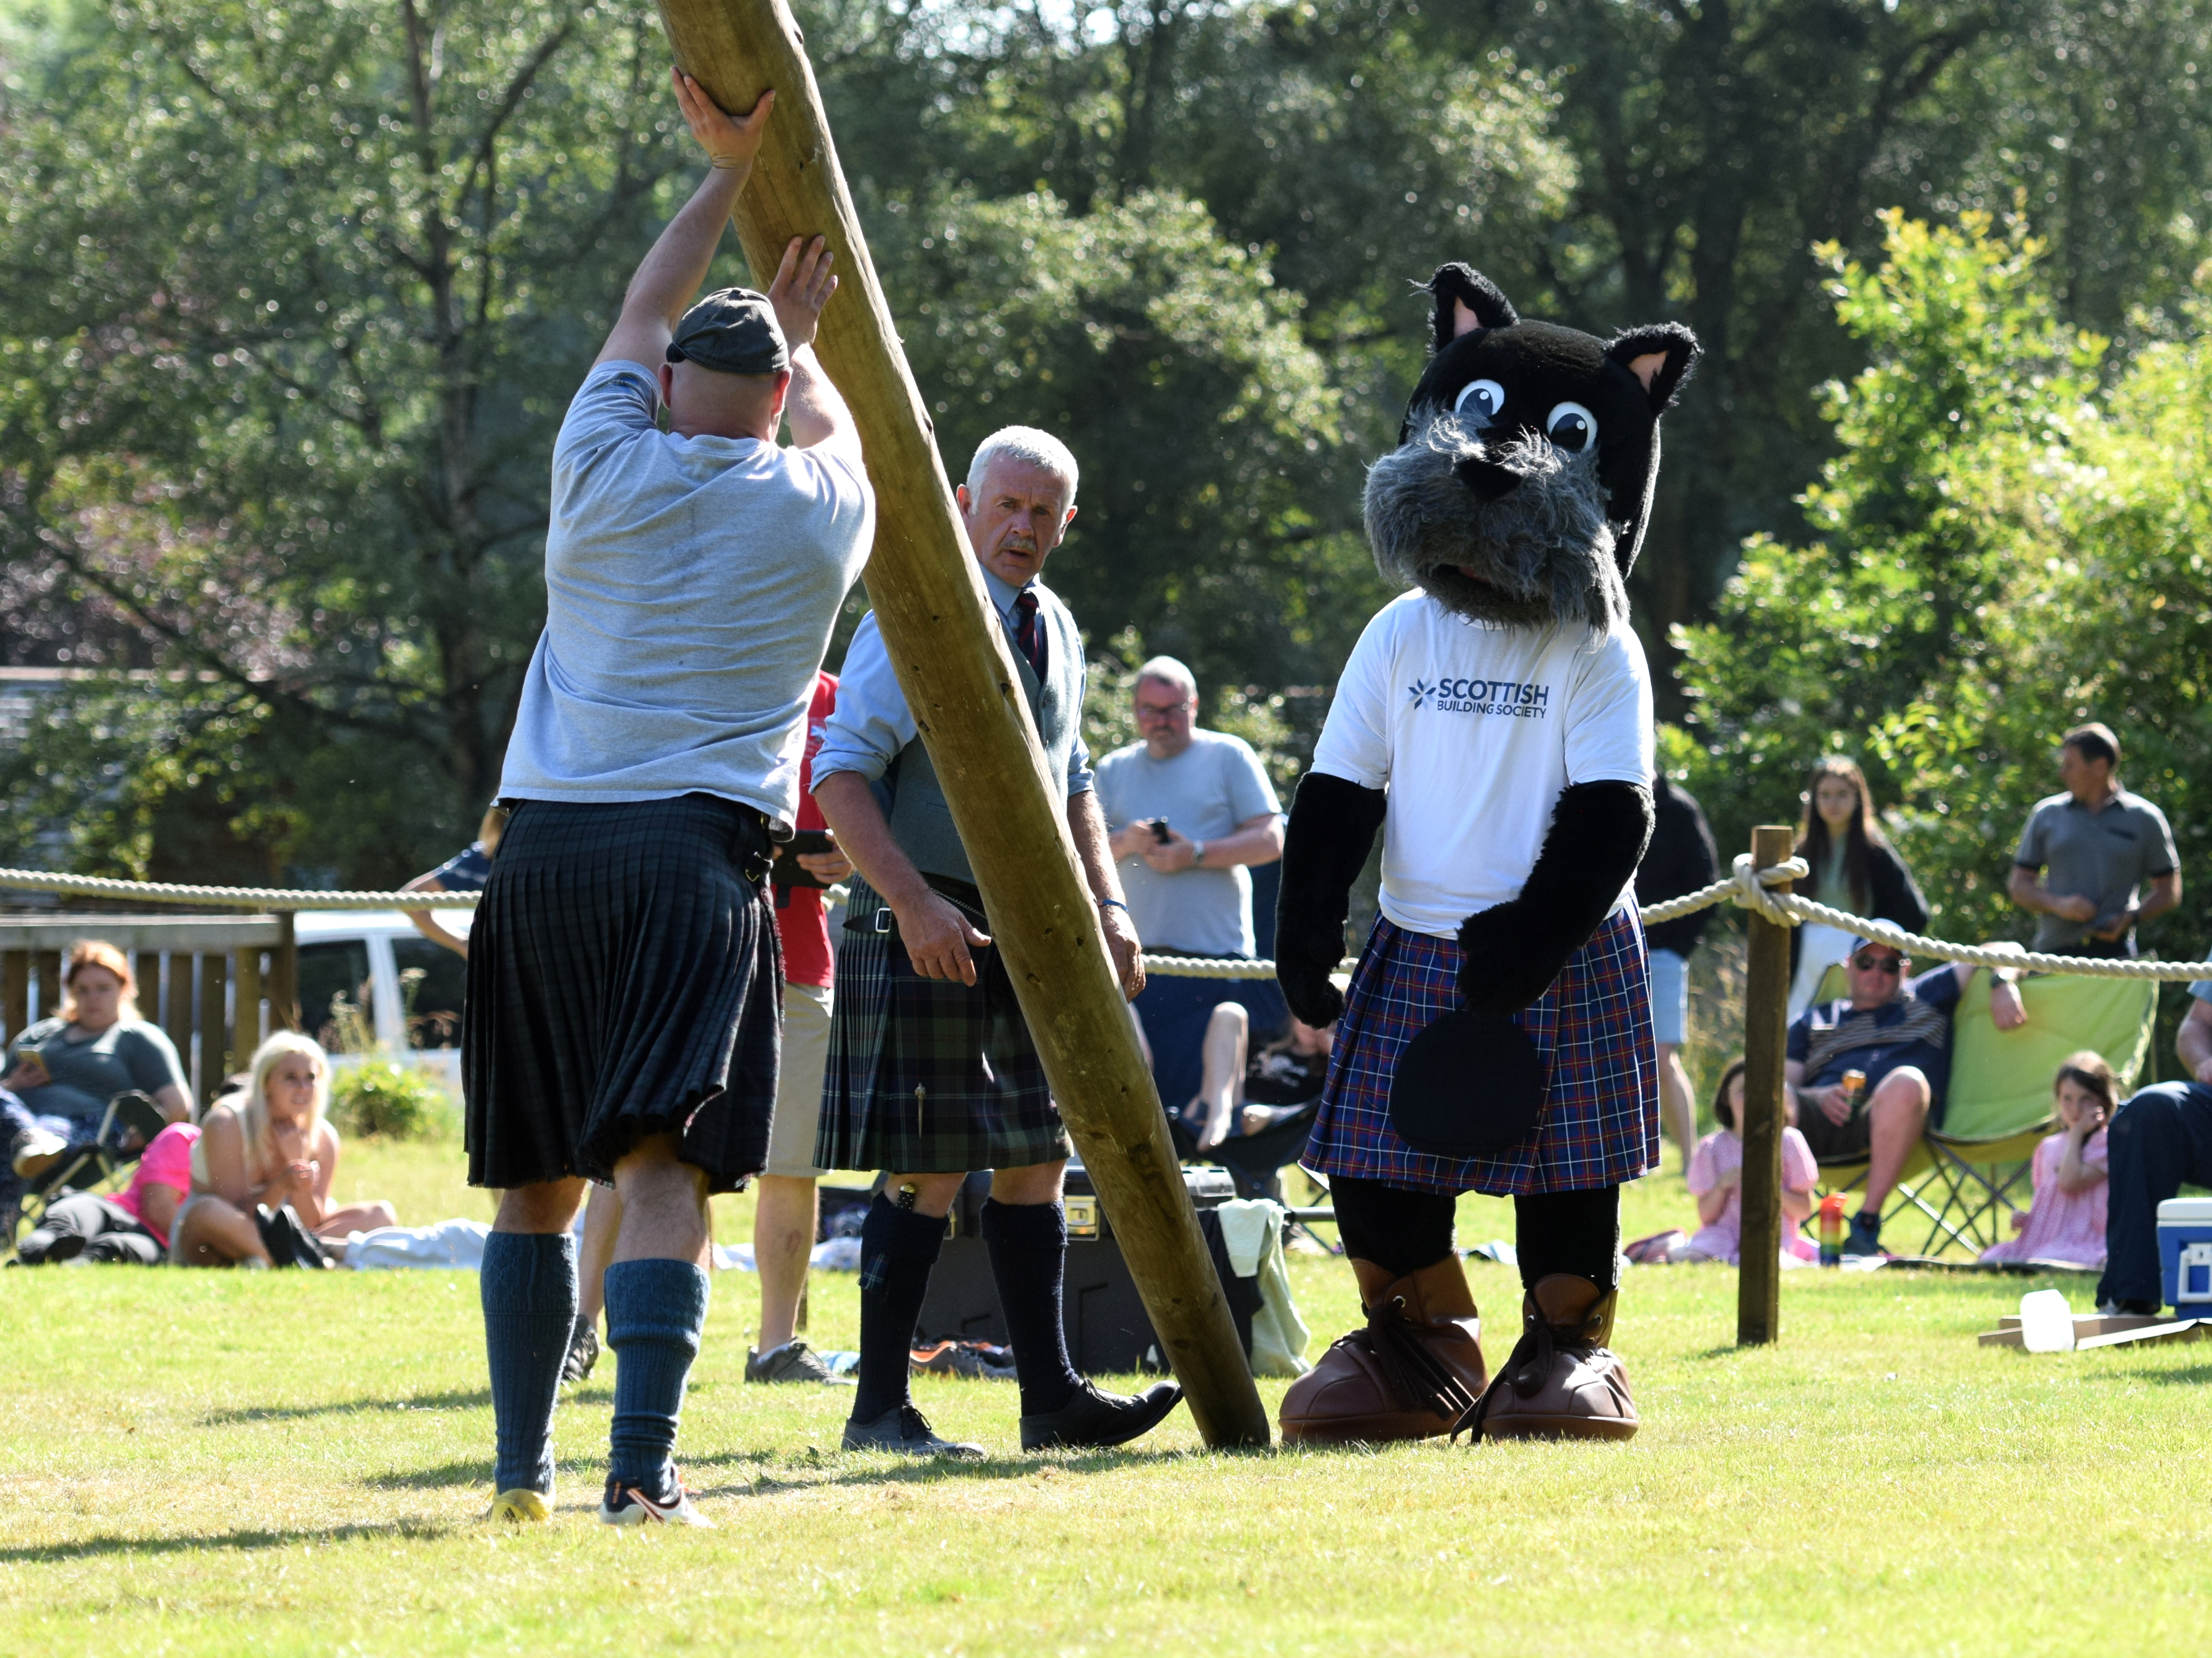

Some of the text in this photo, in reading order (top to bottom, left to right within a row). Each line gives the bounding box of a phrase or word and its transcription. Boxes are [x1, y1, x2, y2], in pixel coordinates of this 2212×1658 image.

[1438, 679, 1549, 705] SCOTTISH
[1438, 701, 1547, 718] BUILDING SOCIETY
